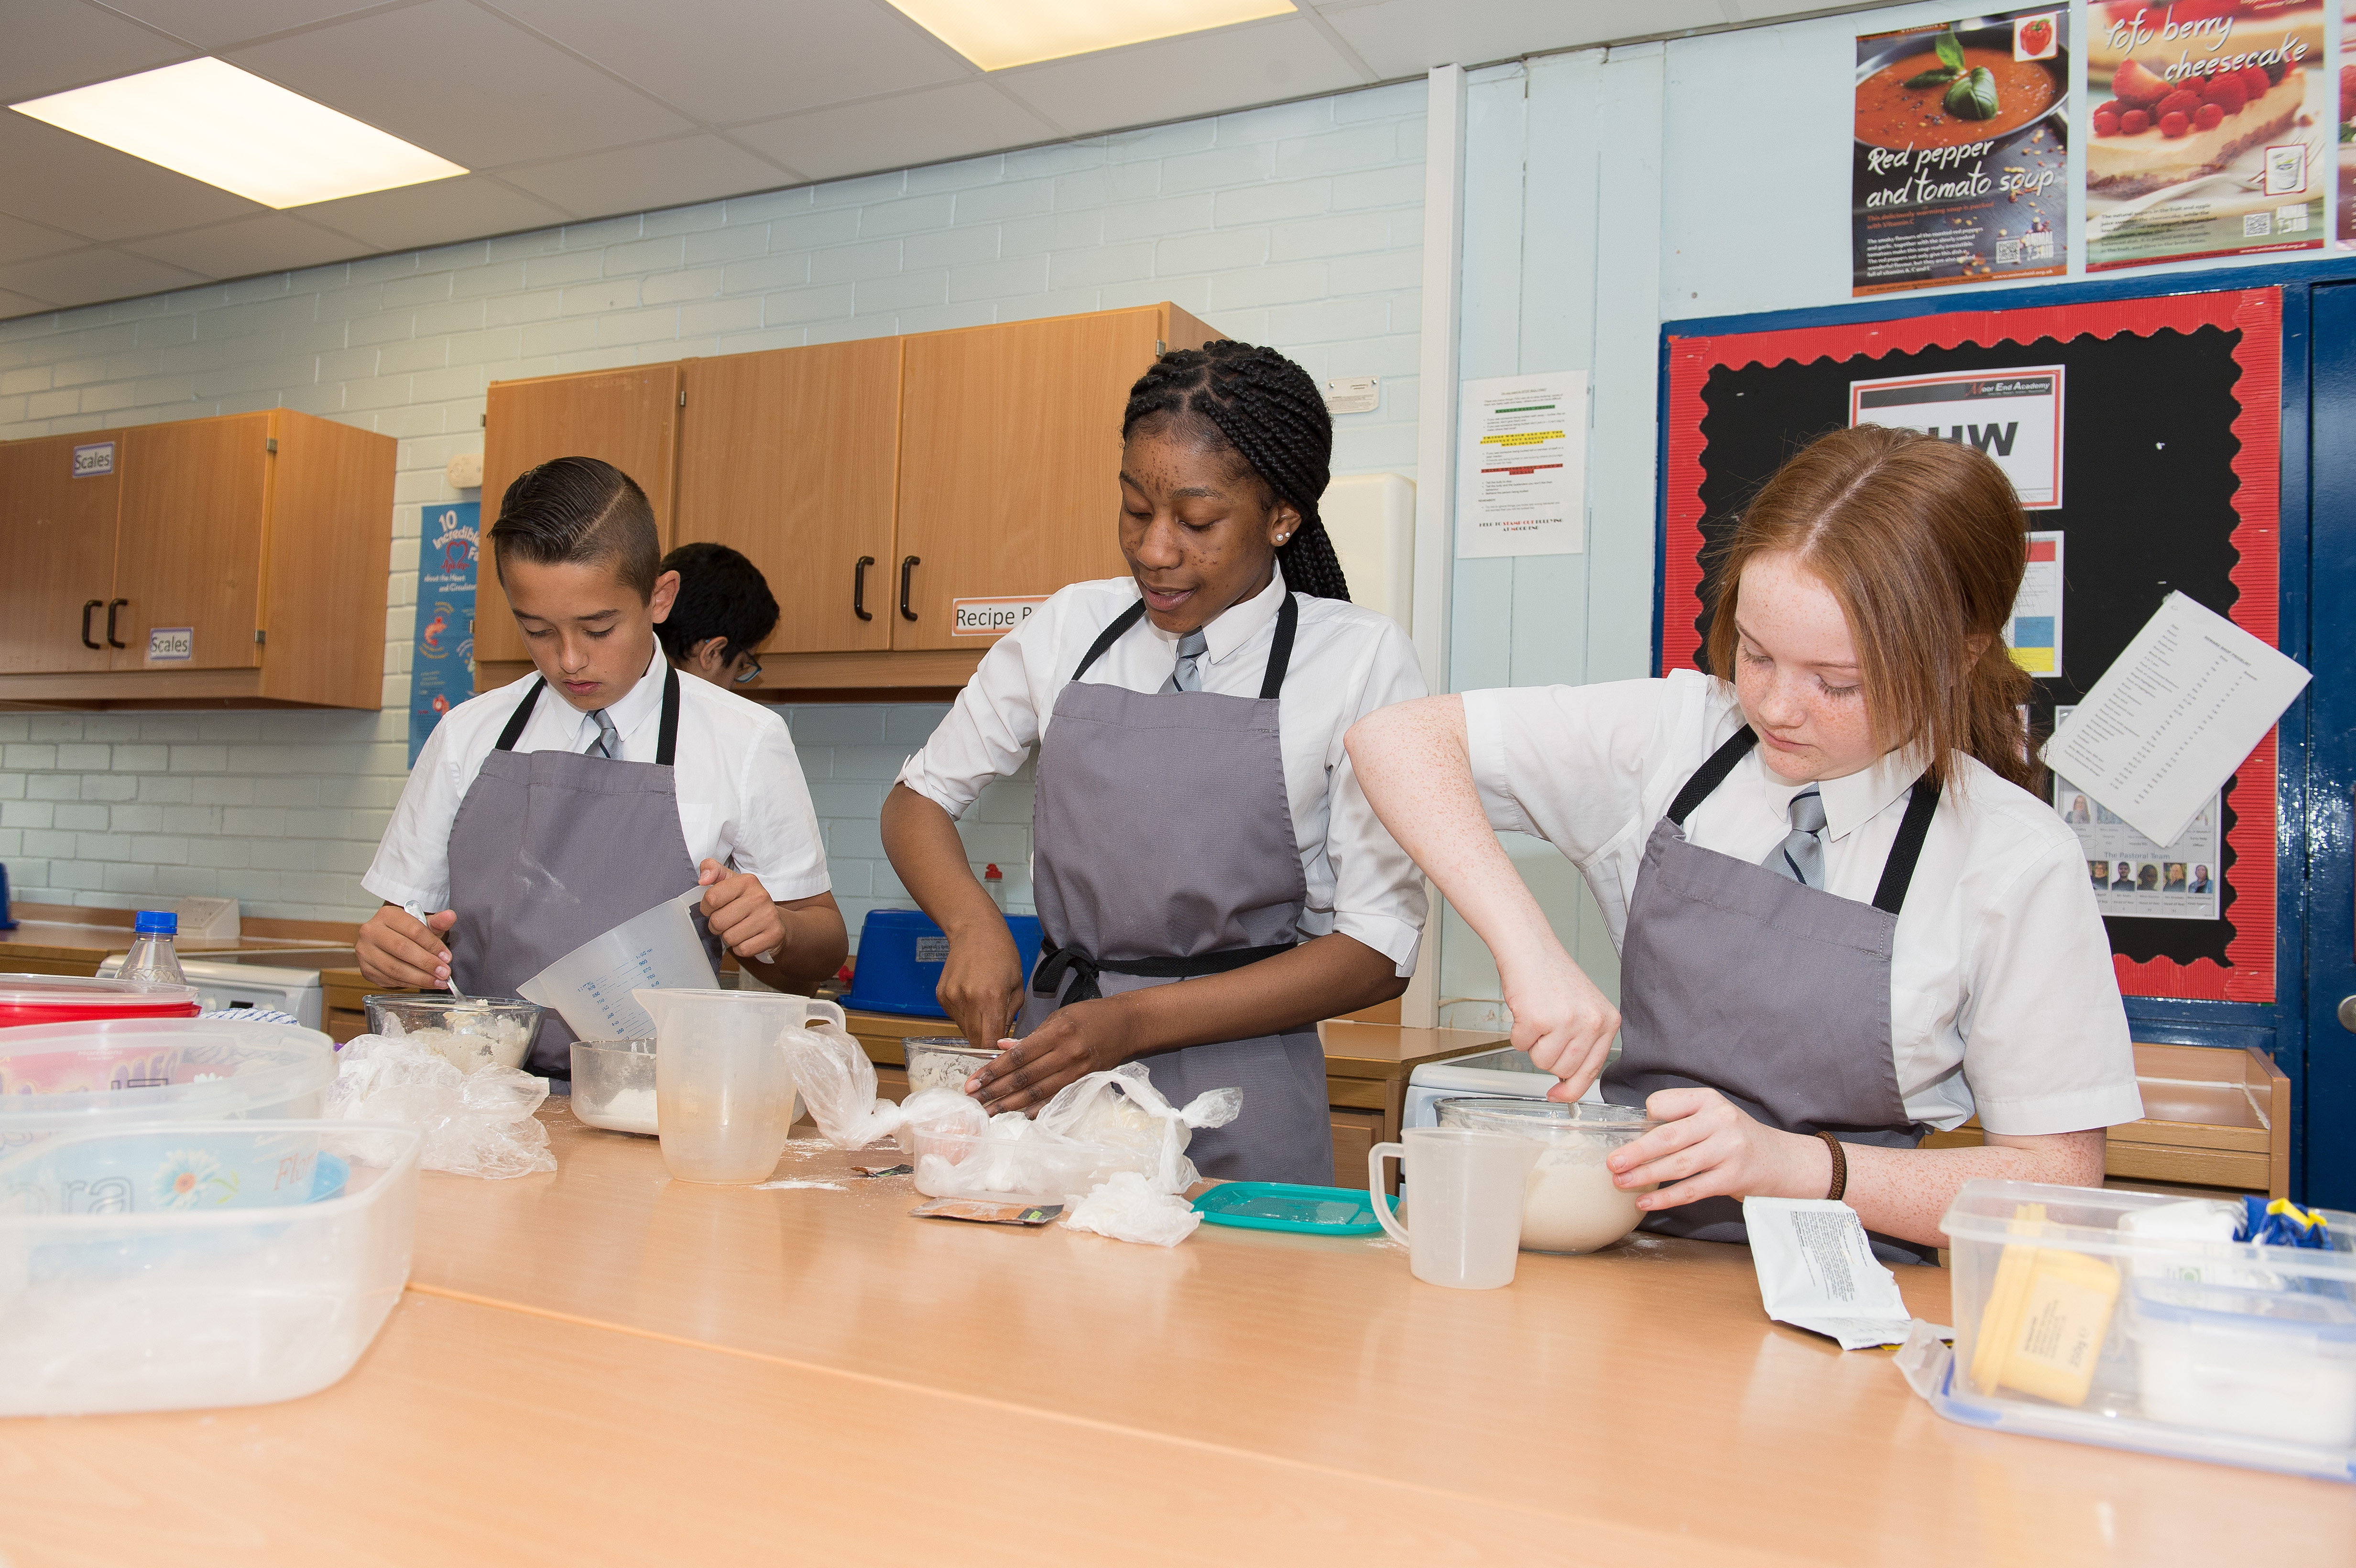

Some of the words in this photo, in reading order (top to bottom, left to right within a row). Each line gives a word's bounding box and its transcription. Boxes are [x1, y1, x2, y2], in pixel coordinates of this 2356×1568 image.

[2163, 4, 2234, 52] berry
[2164, 32, 2309, 81] cheesecake
[1868, 141, 1913, 175] Red
[1914, 141, 1995, 173] pepper
[1866, 176, 1912, 207] and
[1914, 161, 1992, 203] tomato
[1998, 169, 2055, 196] soup
[1964, 382, 1995, 397] Moor
[1995, 382, 2012, 392] End
[2013, 381, 2050, 391] Academy
[75, 453, 109, 470] Scales
[438, 510, 458, 533] 10
[438, 584, 449, 592] and
[956, 608, 1014, 630] Recipe
[151, 635, 187, 655] Scales
[273, 1148, 318, 1192] Flor
